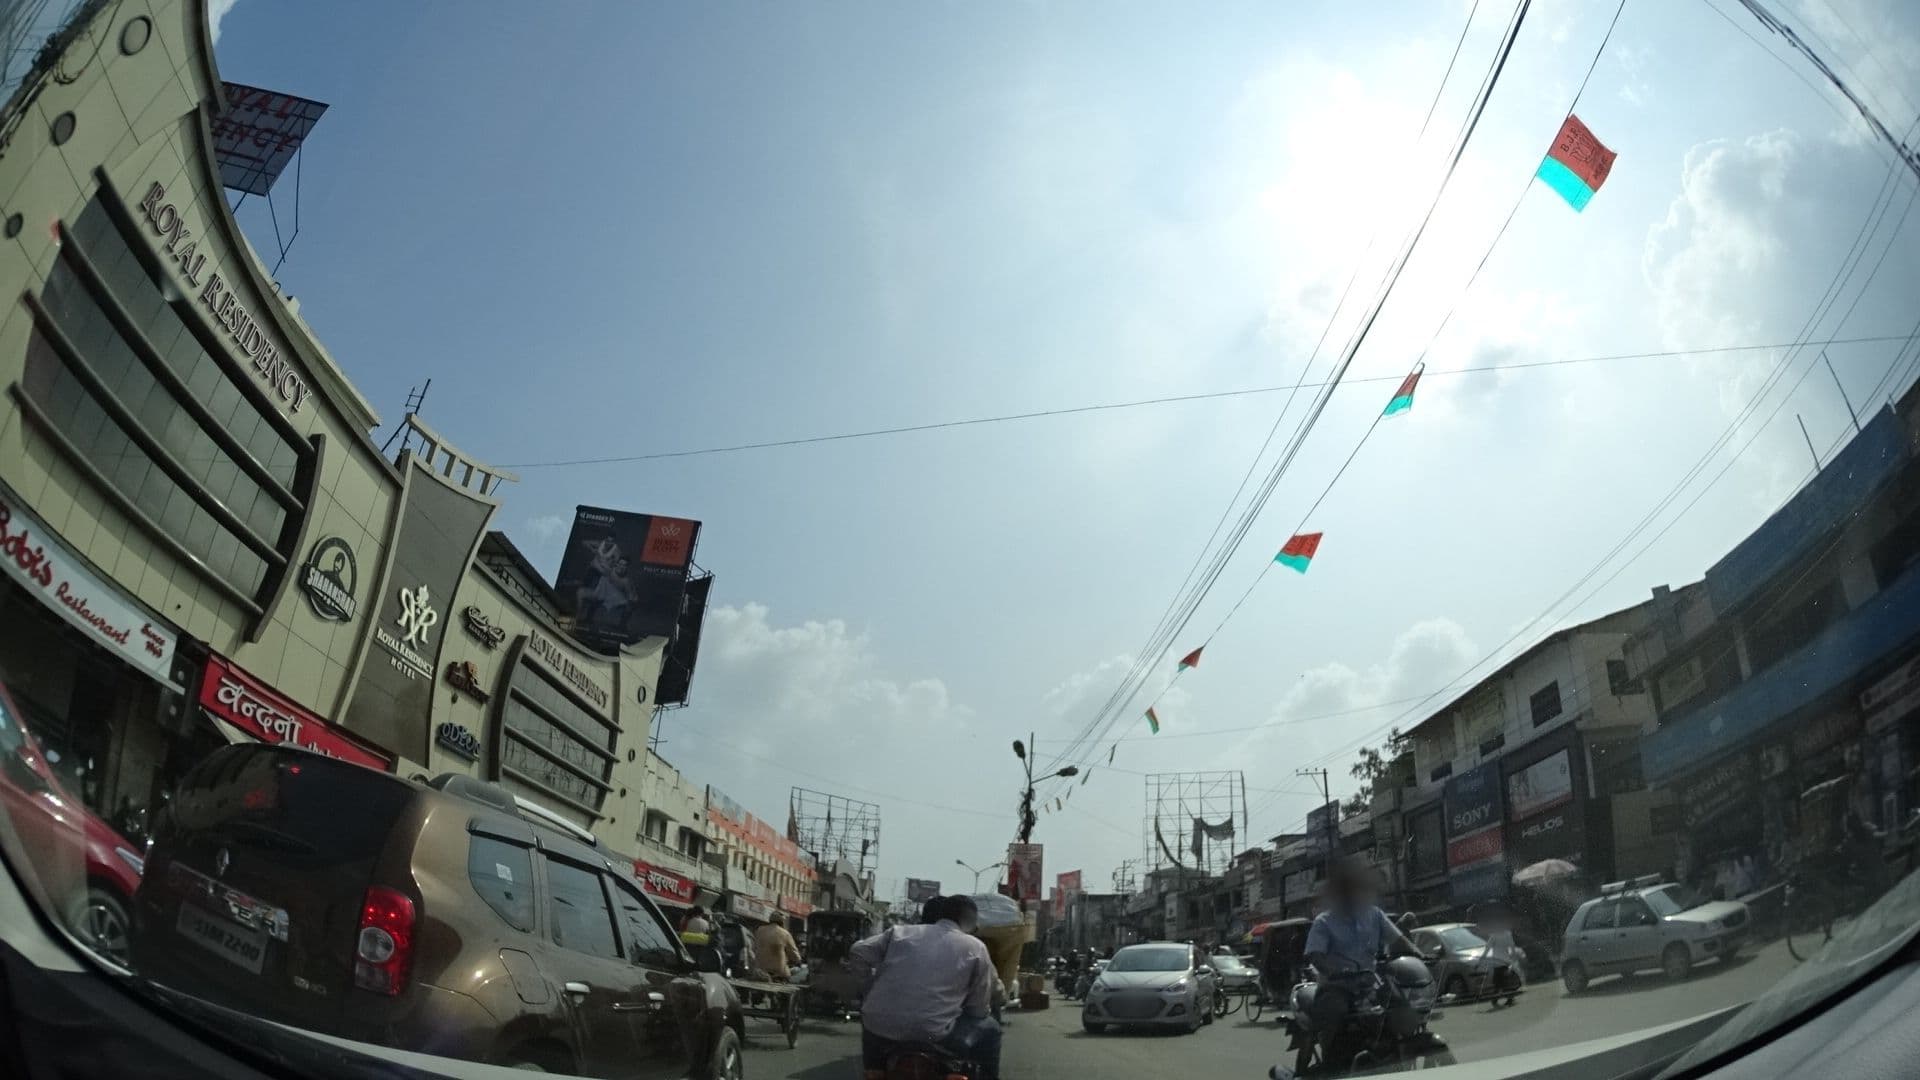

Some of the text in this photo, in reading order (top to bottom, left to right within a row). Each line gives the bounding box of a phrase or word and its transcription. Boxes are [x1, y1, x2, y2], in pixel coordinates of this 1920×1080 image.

[140, 181, 313, 413] ROYAL RESIDENCY
[55, 581, 132, 645] Restaurant
[376, 628, 434, 673] ROYAL RESIDENCY
[389, 656, 417, 680] HOTEL
[1454, 802, 1492, 830] SONY
[1521, 815, 1564, 838] HELIOS
